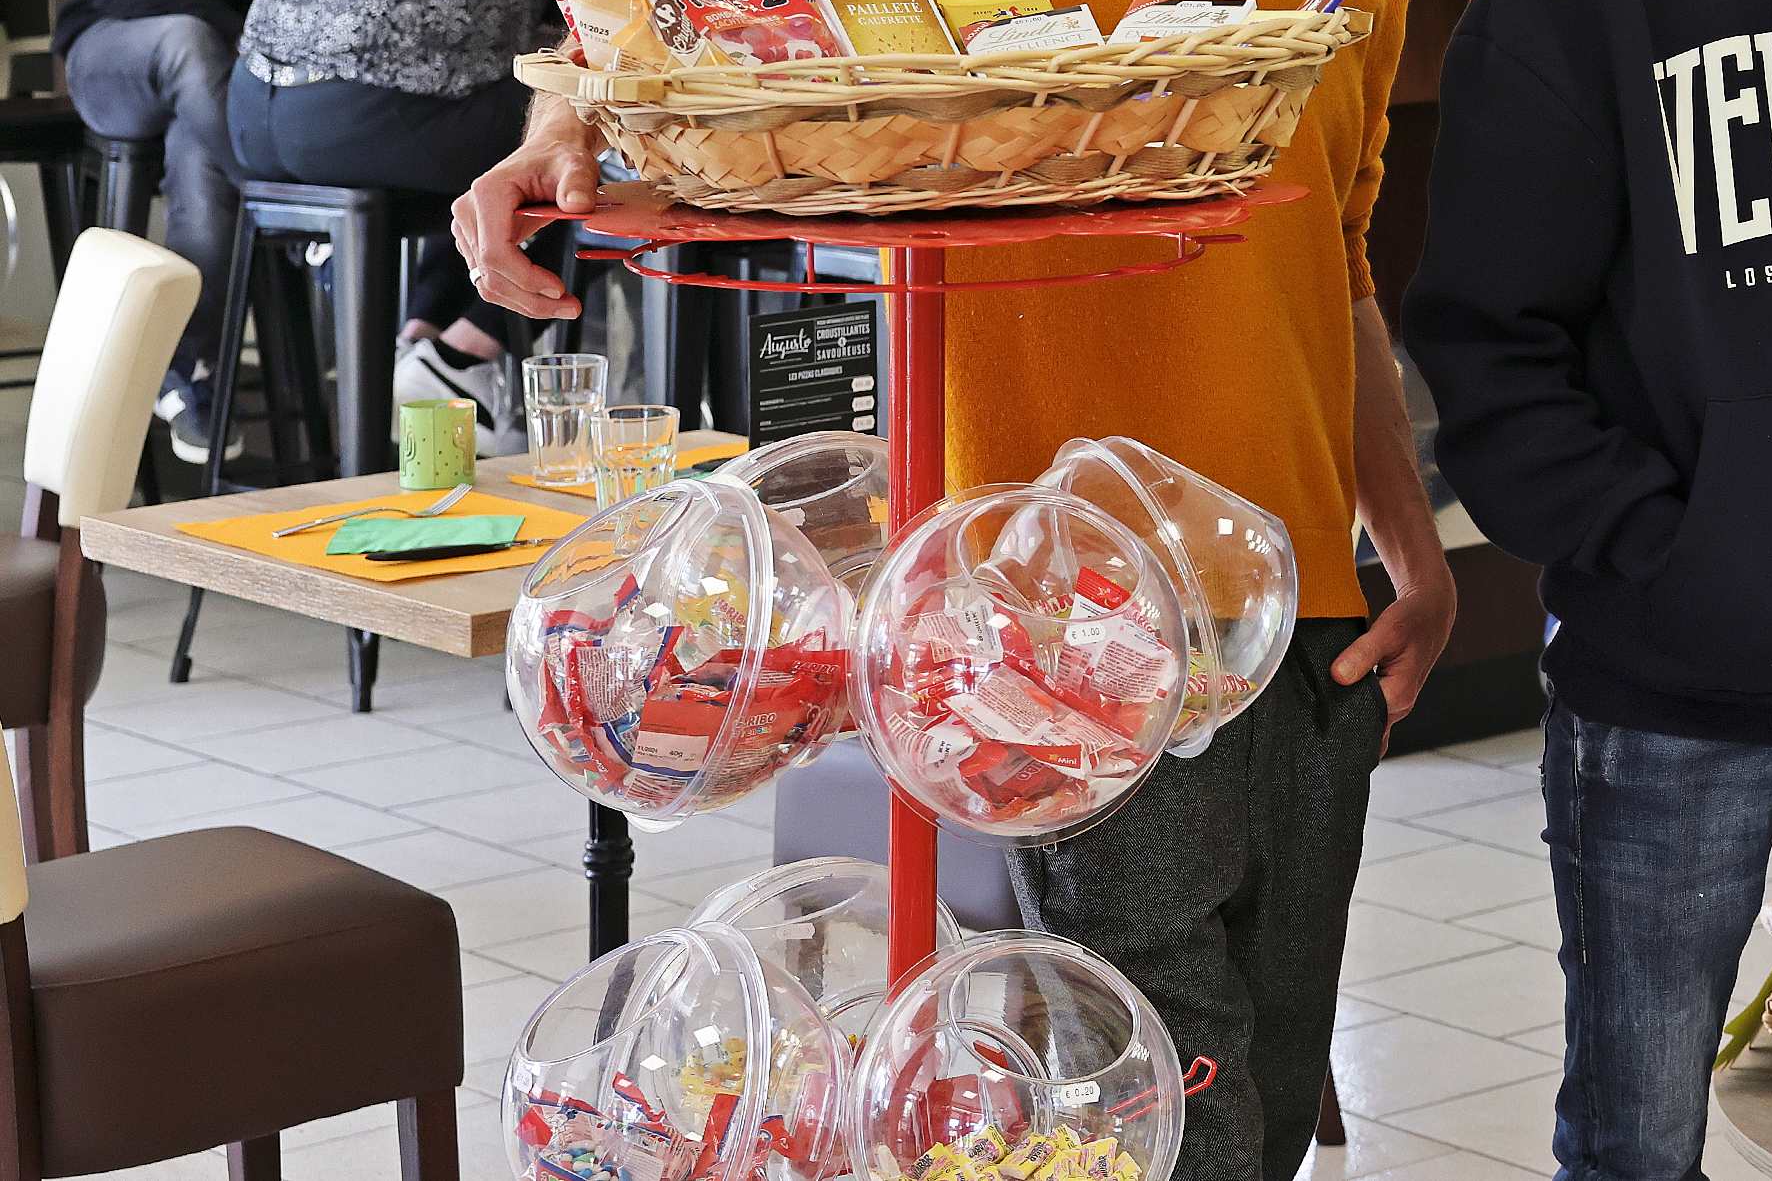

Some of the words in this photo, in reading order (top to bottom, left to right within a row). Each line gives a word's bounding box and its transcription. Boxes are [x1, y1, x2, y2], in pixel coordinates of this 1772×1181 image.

[1135, 9, 1208, 24] Lindt
[988, 19, 1059, 42] Lindt
[816, 323, 870, 341] CROUSTILLANTES
[760, 327, 812, 360] Augusto
[816, 342, 871, 361] SAVOUREUSES
[1082, 626, 1100, 638] 1.00
[1056, 756, 1079, 767] Mini
[1074, 1085, 1095, 1098] 0.20
